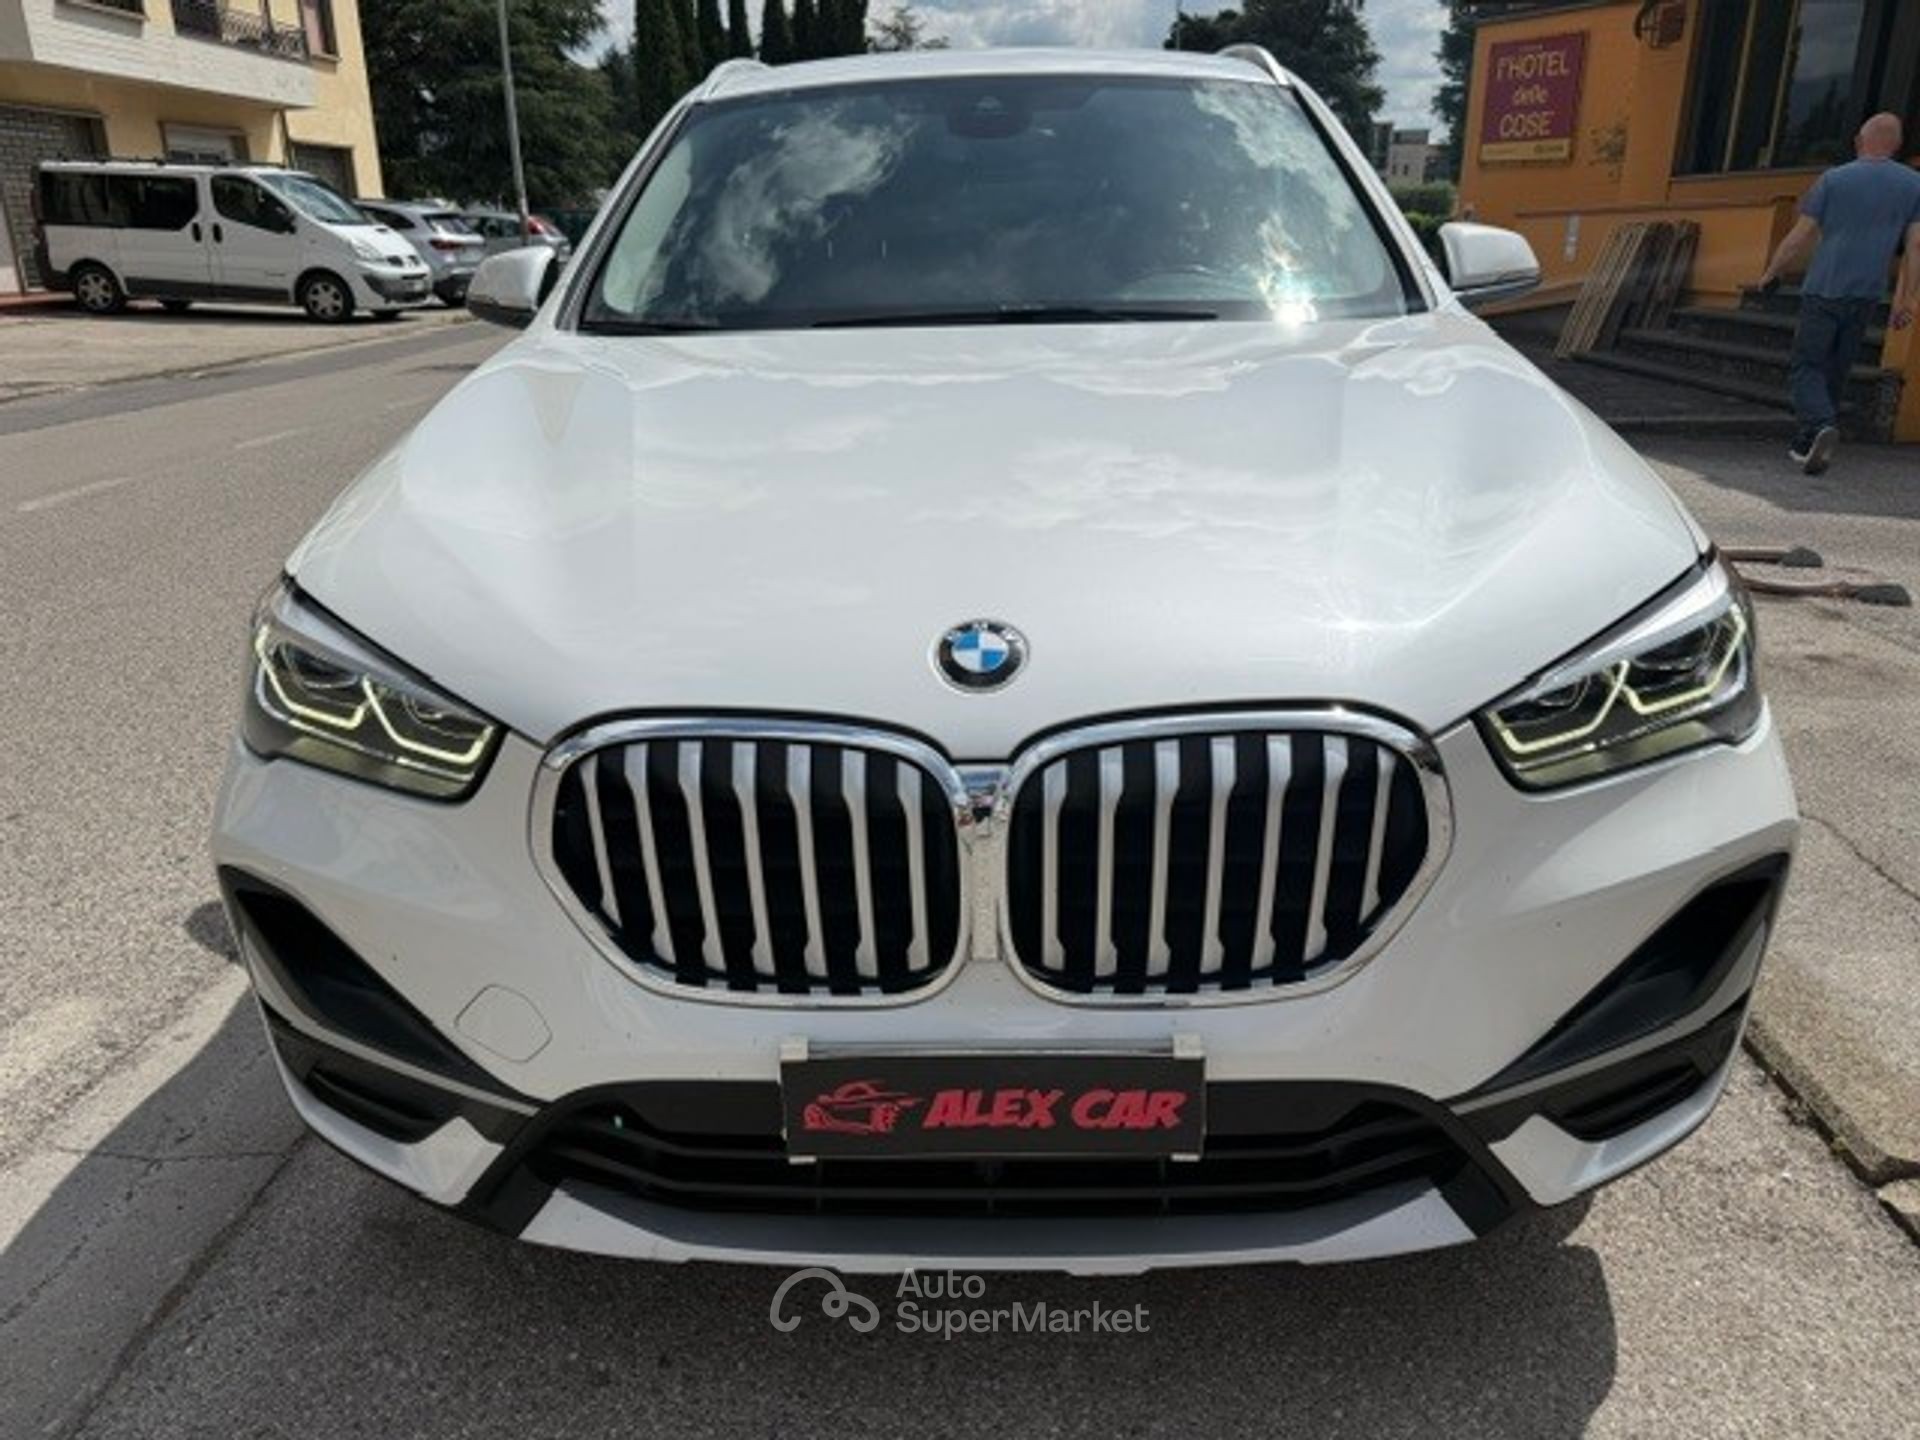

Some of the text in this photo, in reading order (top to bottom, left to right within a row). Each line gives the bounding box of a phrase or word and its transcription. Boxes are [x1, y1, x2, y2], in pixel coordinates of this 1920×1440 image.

[1500, 111, 1555, 138] COSE
[922, 1088, 1187, 1129] ALEX CAR
